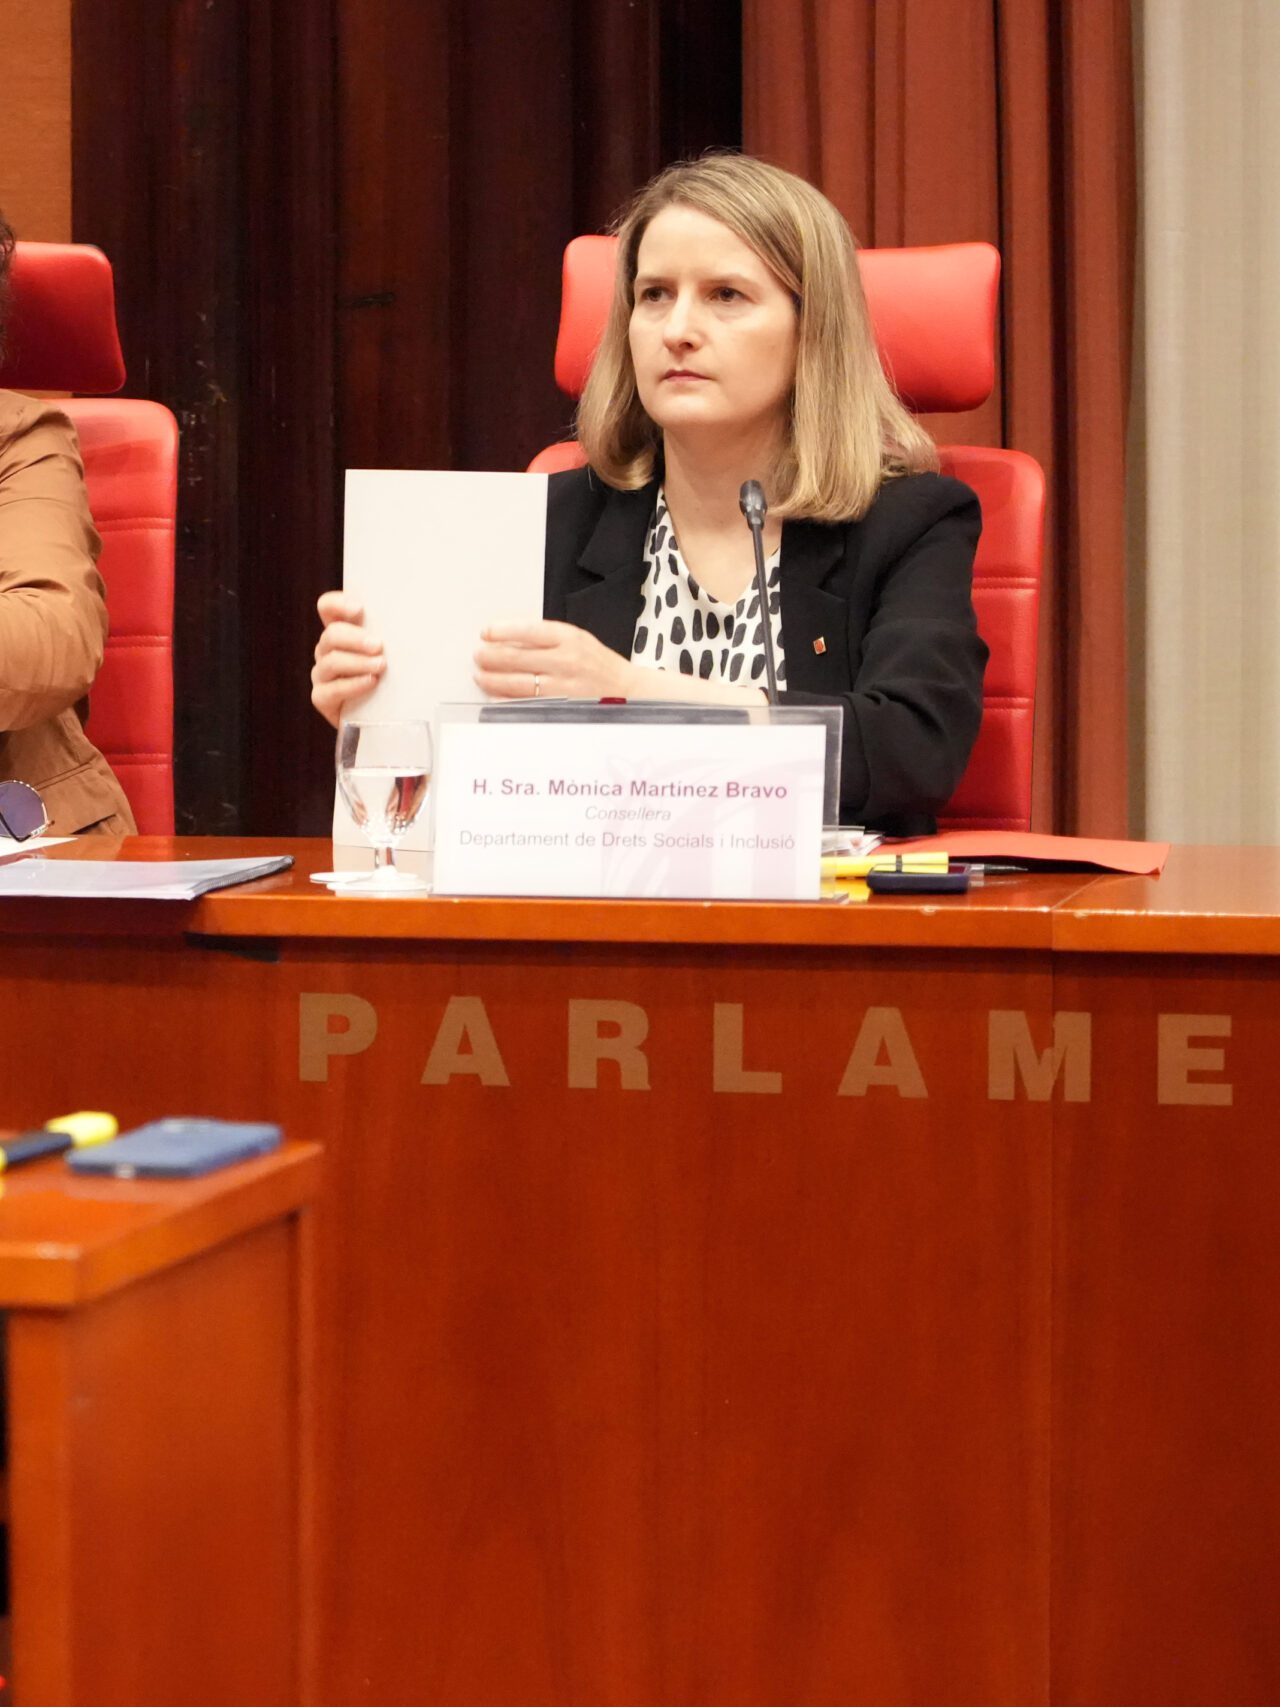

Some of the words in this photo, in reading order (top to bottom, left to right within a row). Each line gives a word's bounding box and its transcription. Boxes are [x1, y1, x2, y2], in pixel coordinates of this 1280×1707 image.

[473, 778, 492, 796] H.
[501, 778, 540, 796] Sra.
[630, 780, 719, 798] Martínez
[726, 781, 788, 799] Bravo
[585, 805, 672, 821] Consellera
[460, 830, 569, 848] Departament
[575, 832, 596, 847] de
[602, 831, 647, 848] Drets
[653, 832, 714, 849] Socials
[731, 833, 796, 850] Inclusió
[298, 991, 1234, 1107] PARLAME
